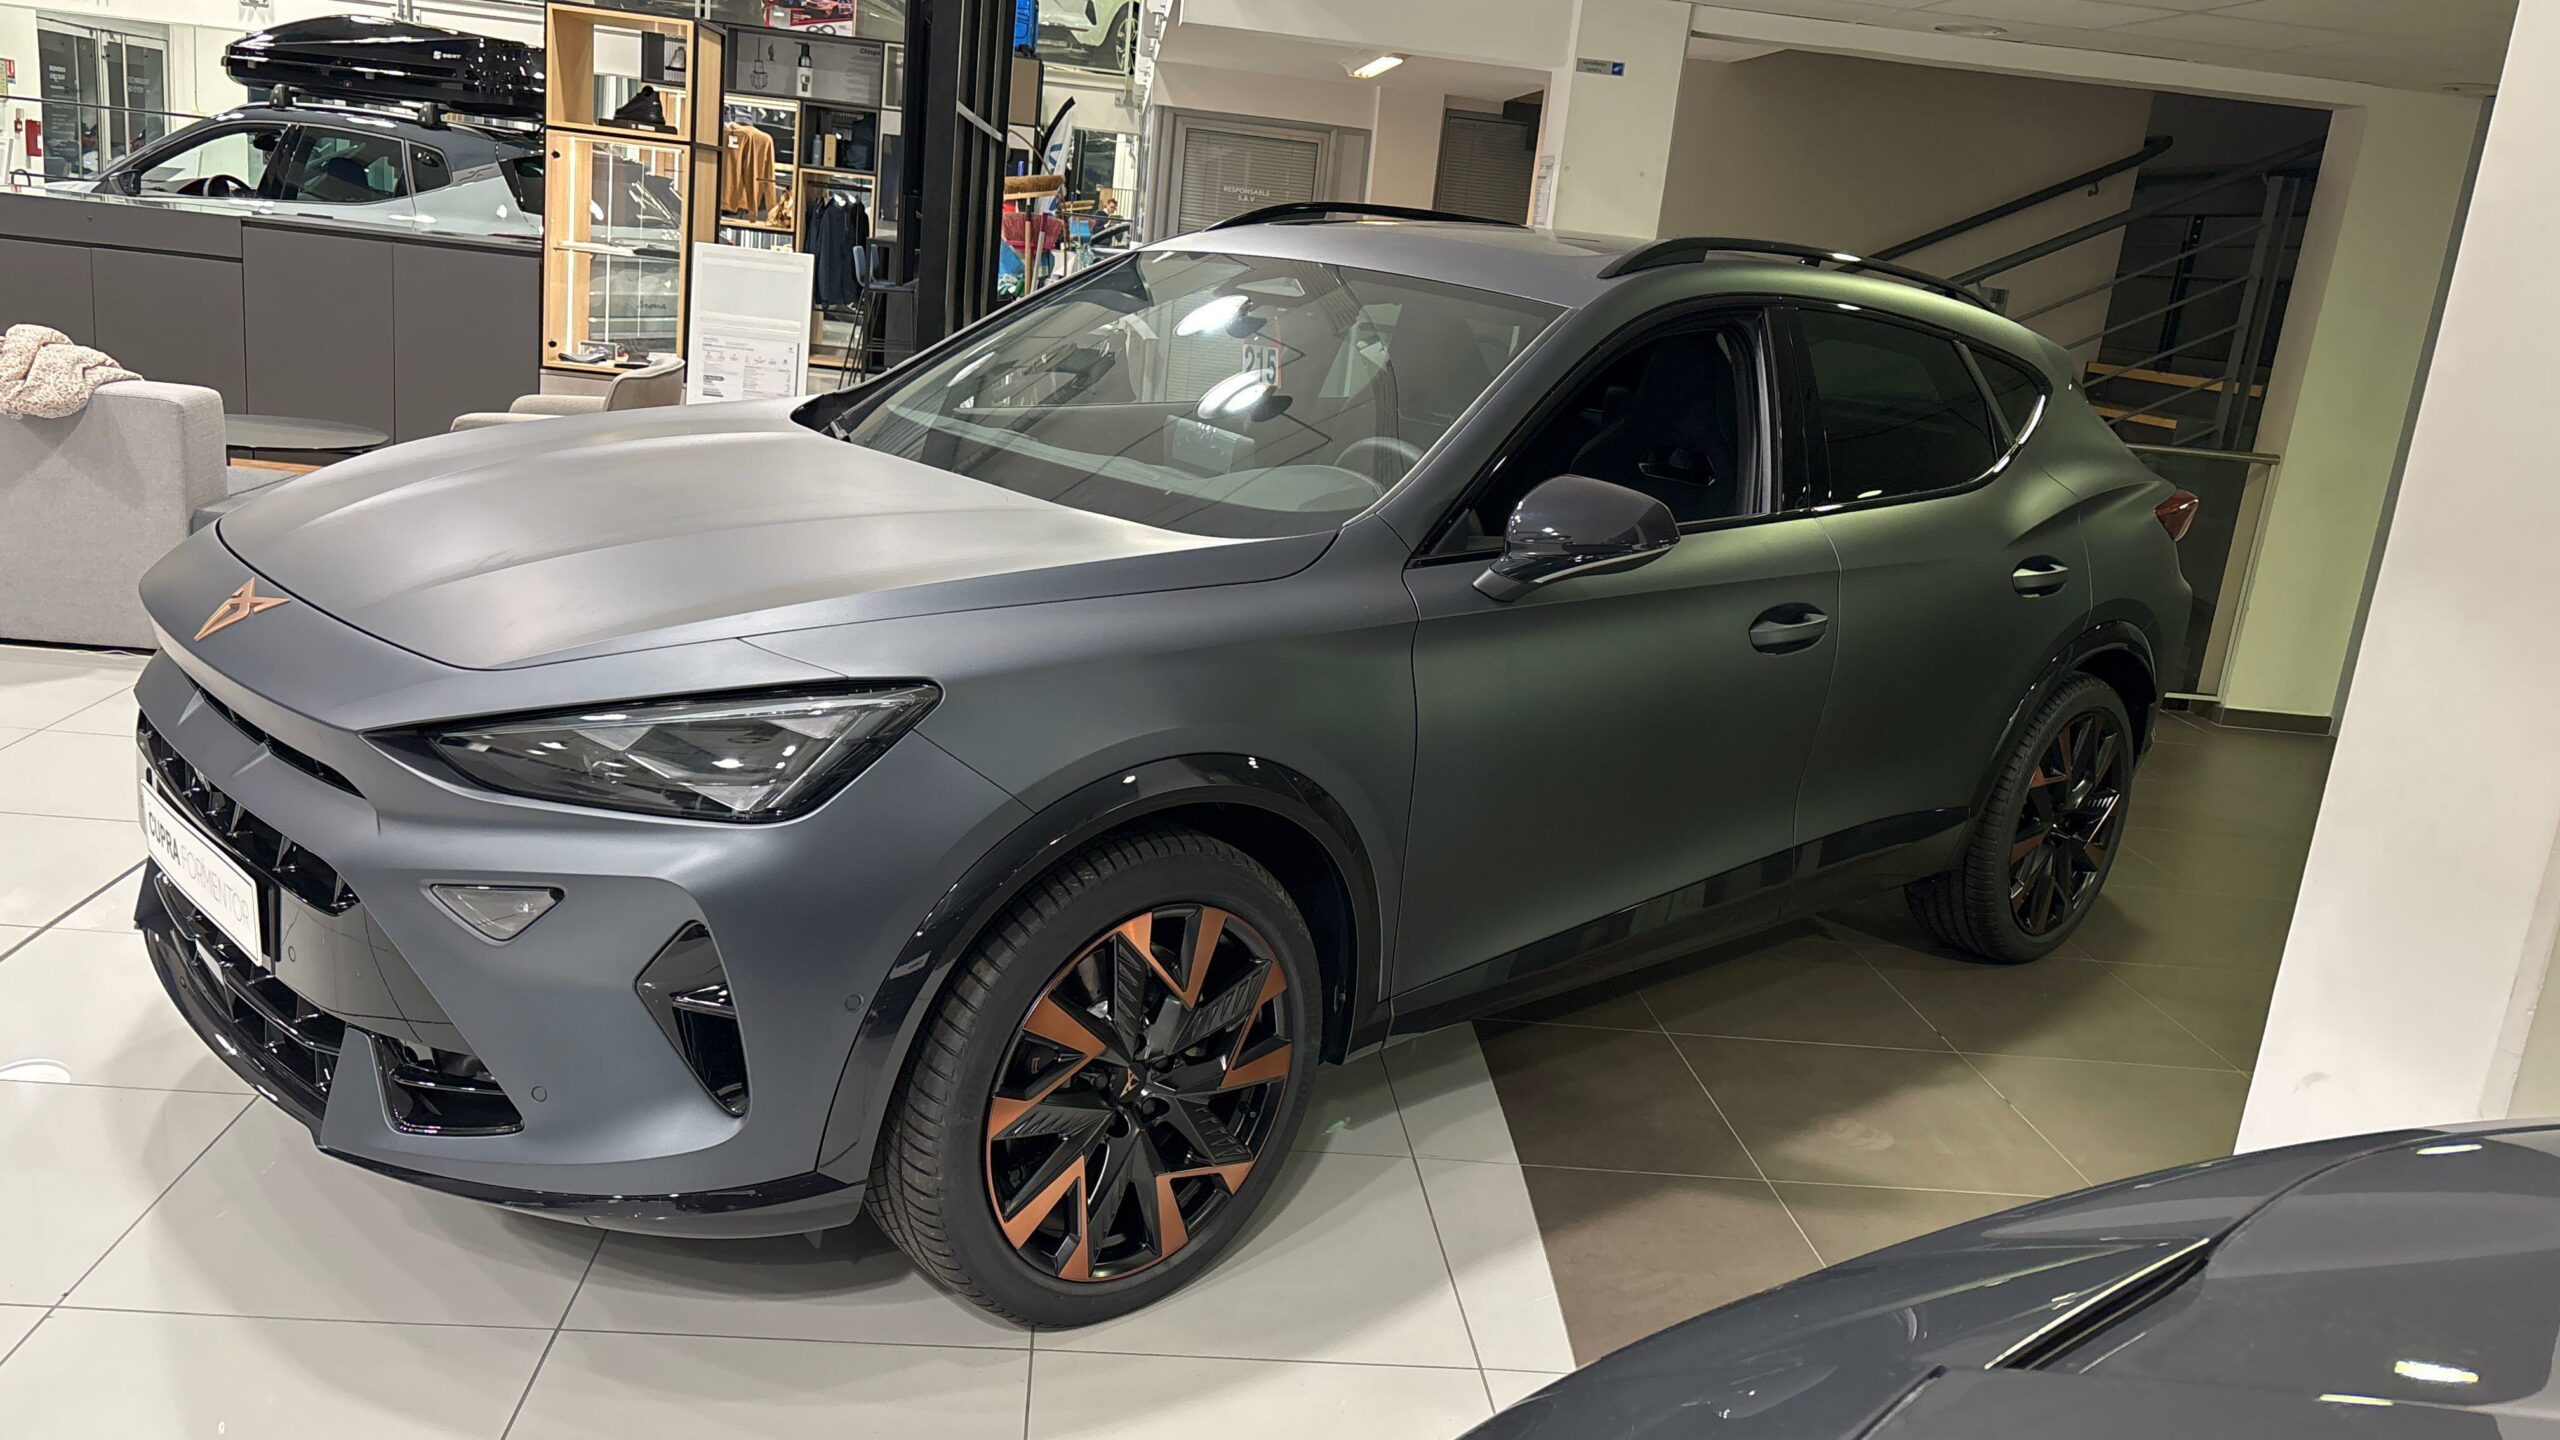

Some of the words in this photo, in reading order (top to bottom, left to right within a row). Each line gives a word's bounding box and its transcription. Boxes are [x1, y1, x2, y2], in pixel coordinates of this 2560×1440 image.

[1223, 185, 1270, 197] RESPONSABLE
[1245, 346, 1276, 385] 215
[148, 812, 181, 866] CUPRA
[181, 844, 250, 926] FORMENTOR
